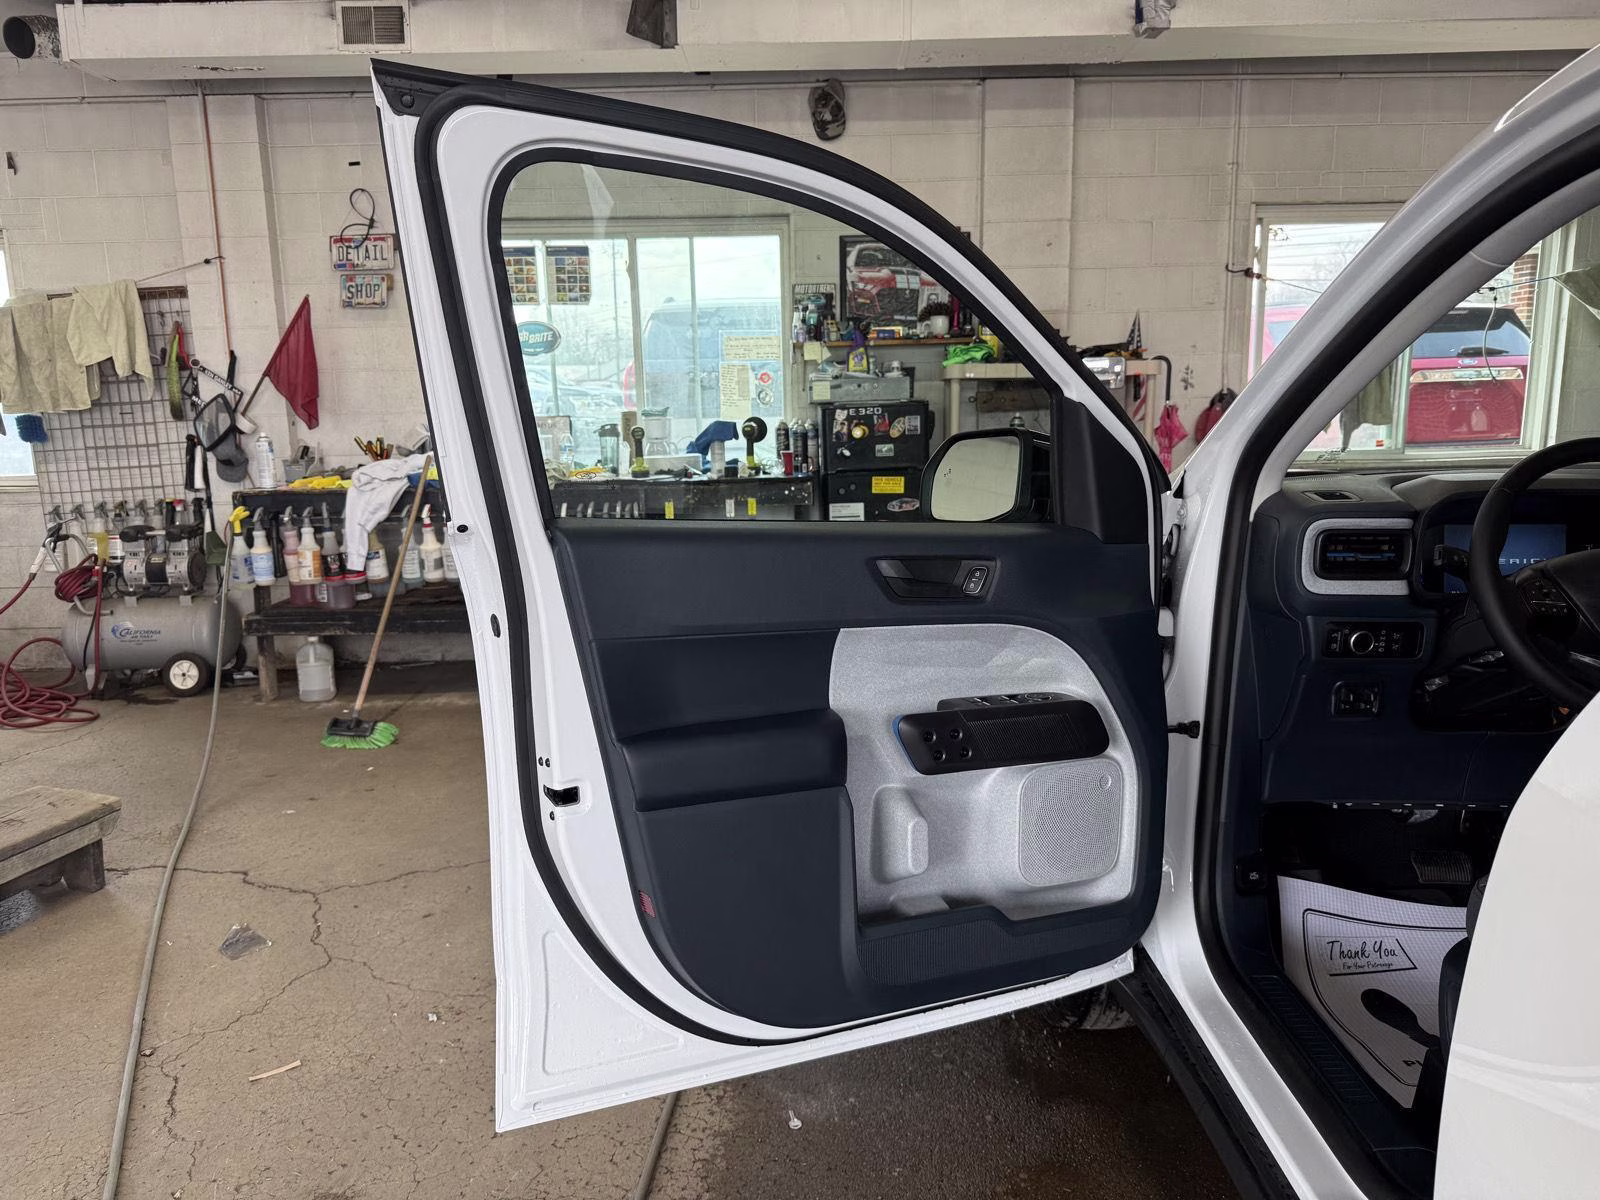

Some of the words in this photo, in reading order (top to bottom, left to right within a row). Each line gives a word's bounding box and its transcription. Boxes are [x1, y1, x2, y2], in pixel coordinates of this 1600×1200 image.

[338, 244, 387, 262] DETAIL
[347, 283, 380, 300] SHOP
[120, 628, 161, 638] CALIFORNIA
[1327, 940, 1370, 961] Thank
[1373, 940, 1398, 960] You
